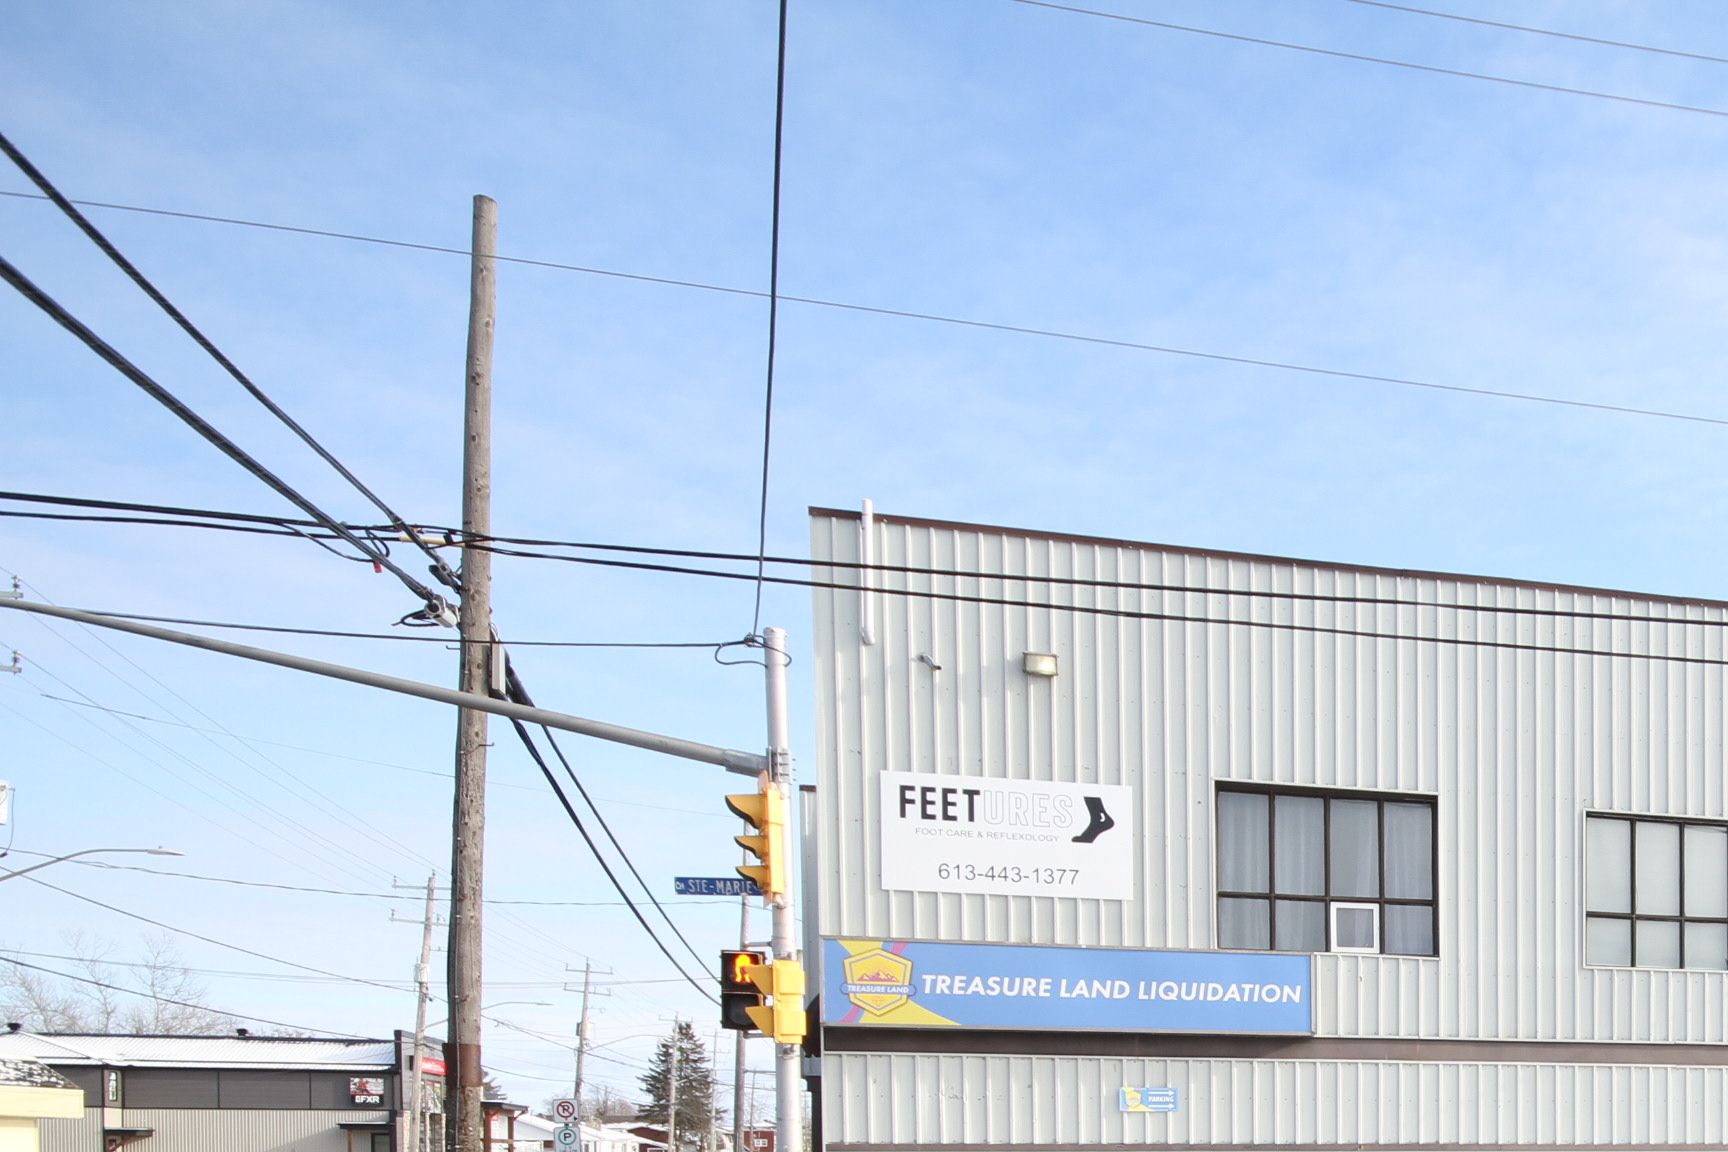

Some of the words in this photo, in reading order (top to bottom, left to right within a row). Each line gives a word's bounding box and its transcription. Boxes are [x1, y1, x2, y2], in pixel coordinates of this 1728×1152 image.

[899, 785, 1073, 829] FEETURES
[915, 827, 943, 837] FOOT
[946, 829, 974, 839] CARE
[977, 831, 984, 839] &
[986, 831, 1060, 843] REFLEXOLOGY
[938, 863, 1080, 886] 613-443-1377
[688, 879, 753, 894] STE-MARIE
[848, 984, 885, 993] TREASURE
[887, 985, 910, 994] LAND
[922, 974, 1053, 997] TREASURE
[1060, 978, 1130, 1000] LAND
[1138, 981, 1302, 1004] LIQUIDATION
